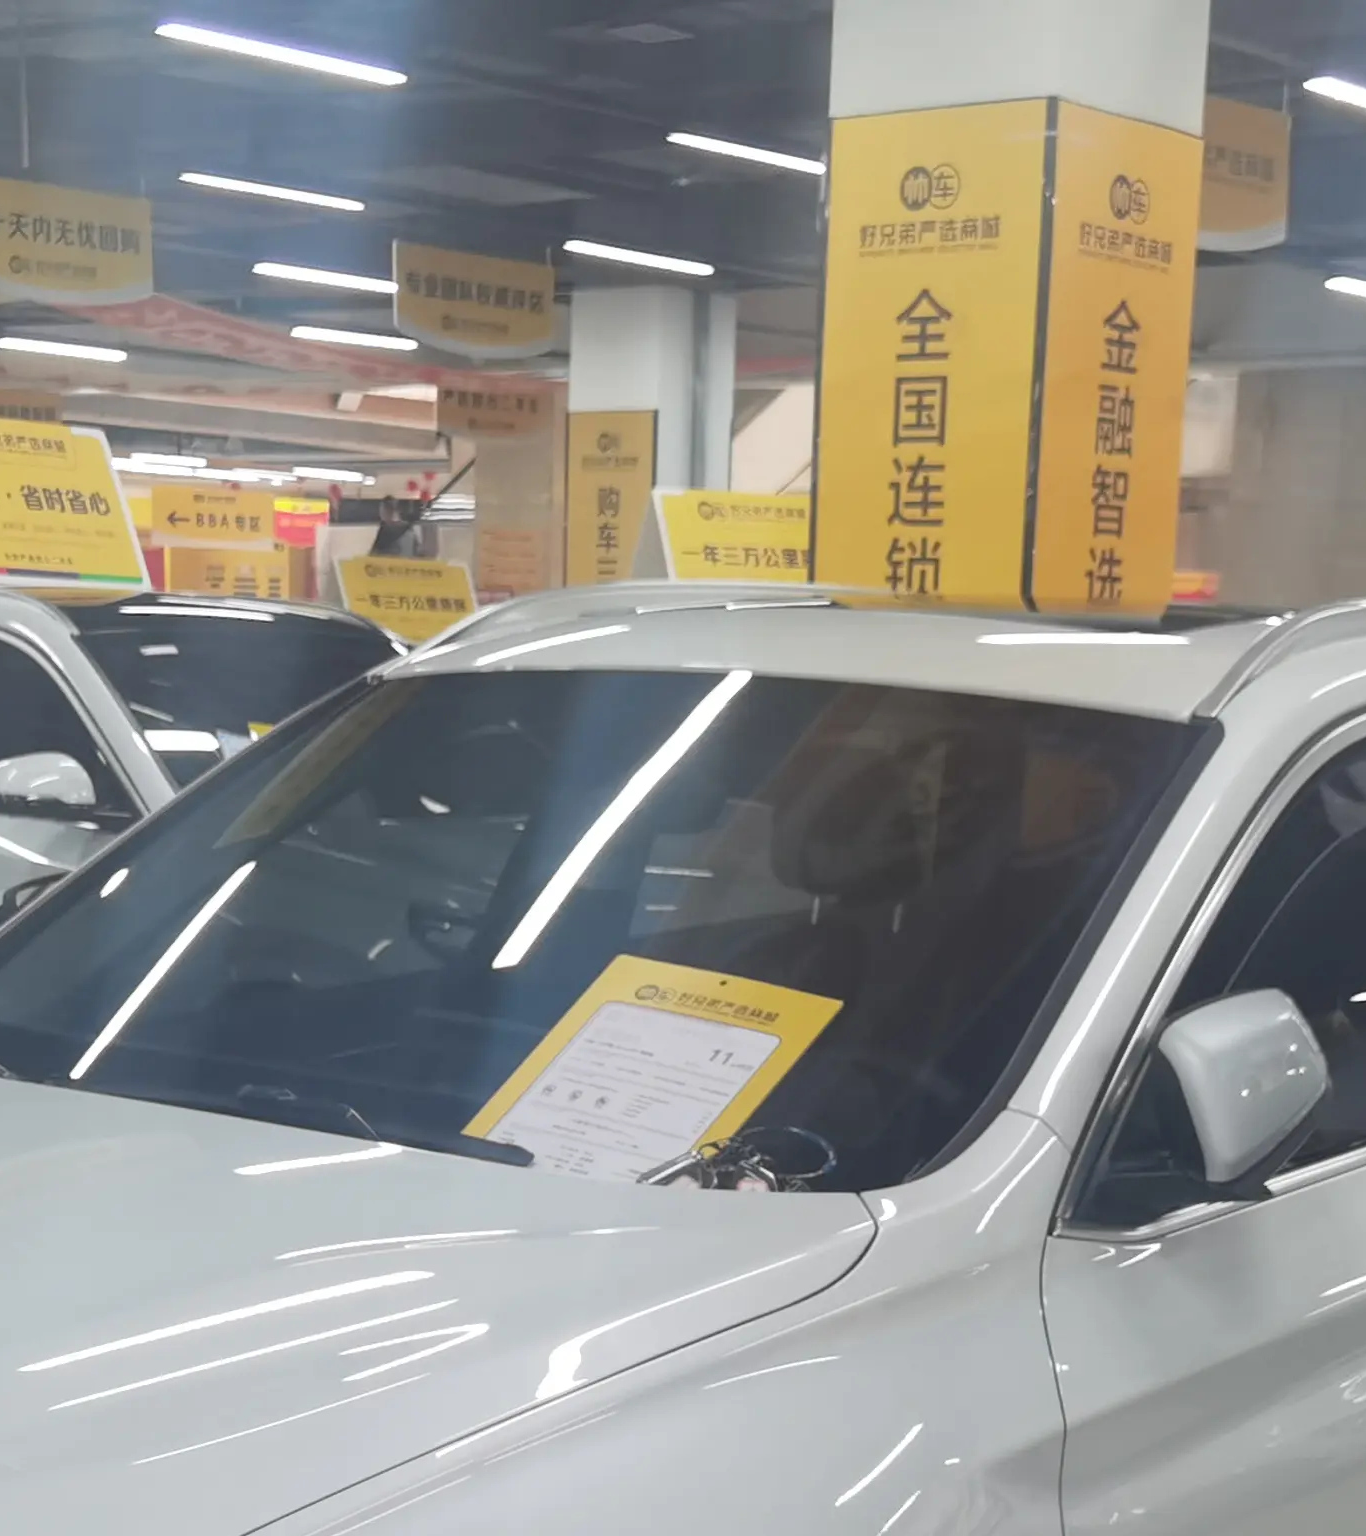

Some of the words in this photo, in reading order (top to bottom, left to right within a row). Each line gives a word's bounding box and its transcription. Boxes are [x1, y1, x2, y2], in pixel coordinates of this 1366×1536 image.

[885, 288, 953, 598] 全国连锁
[1085, 300, 1141, 603] 金融智选
